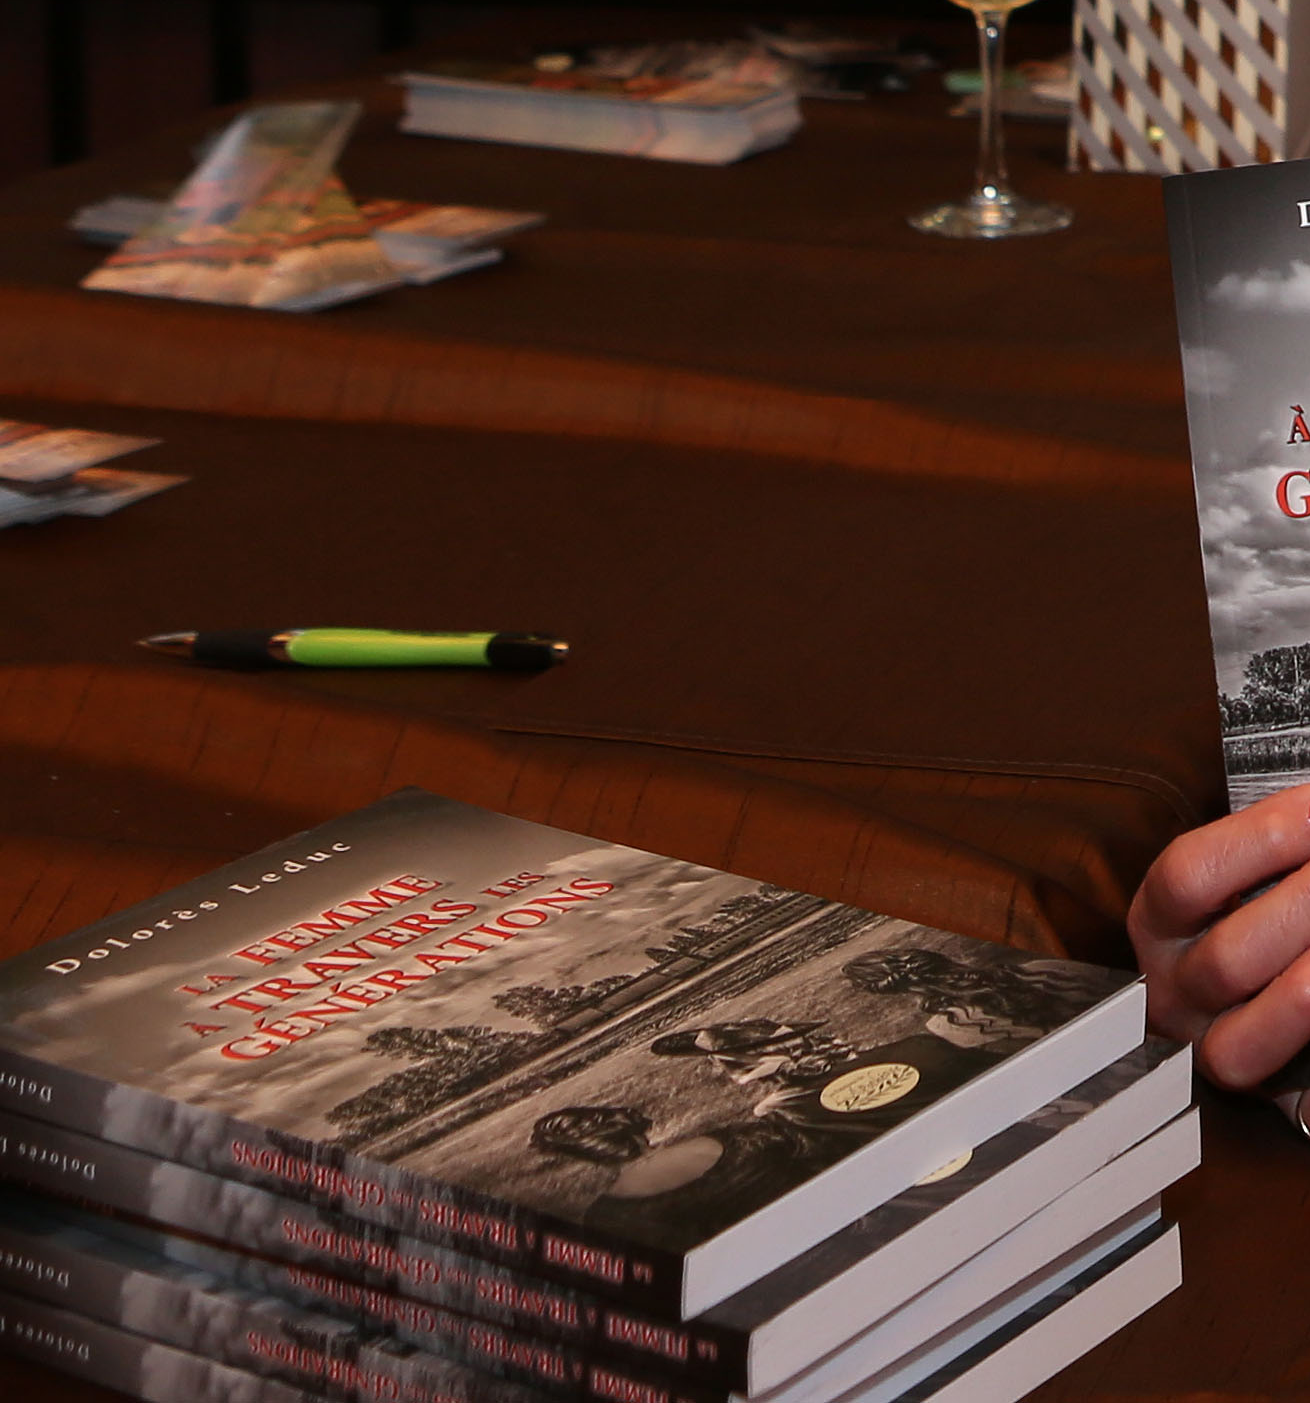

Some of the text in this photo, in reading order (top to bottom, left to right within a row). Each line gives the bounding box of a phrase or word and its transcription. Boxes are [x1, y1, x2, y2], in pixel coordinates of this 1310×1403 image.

[45, 838, 352, 977] Dolorès Leduc
[176, 872, 443, 998] LA FEMME
[184, 870, 546, 1038] À TRAVERS LES
[220, 876, 616, 1063] GÉNÉRATIONS
